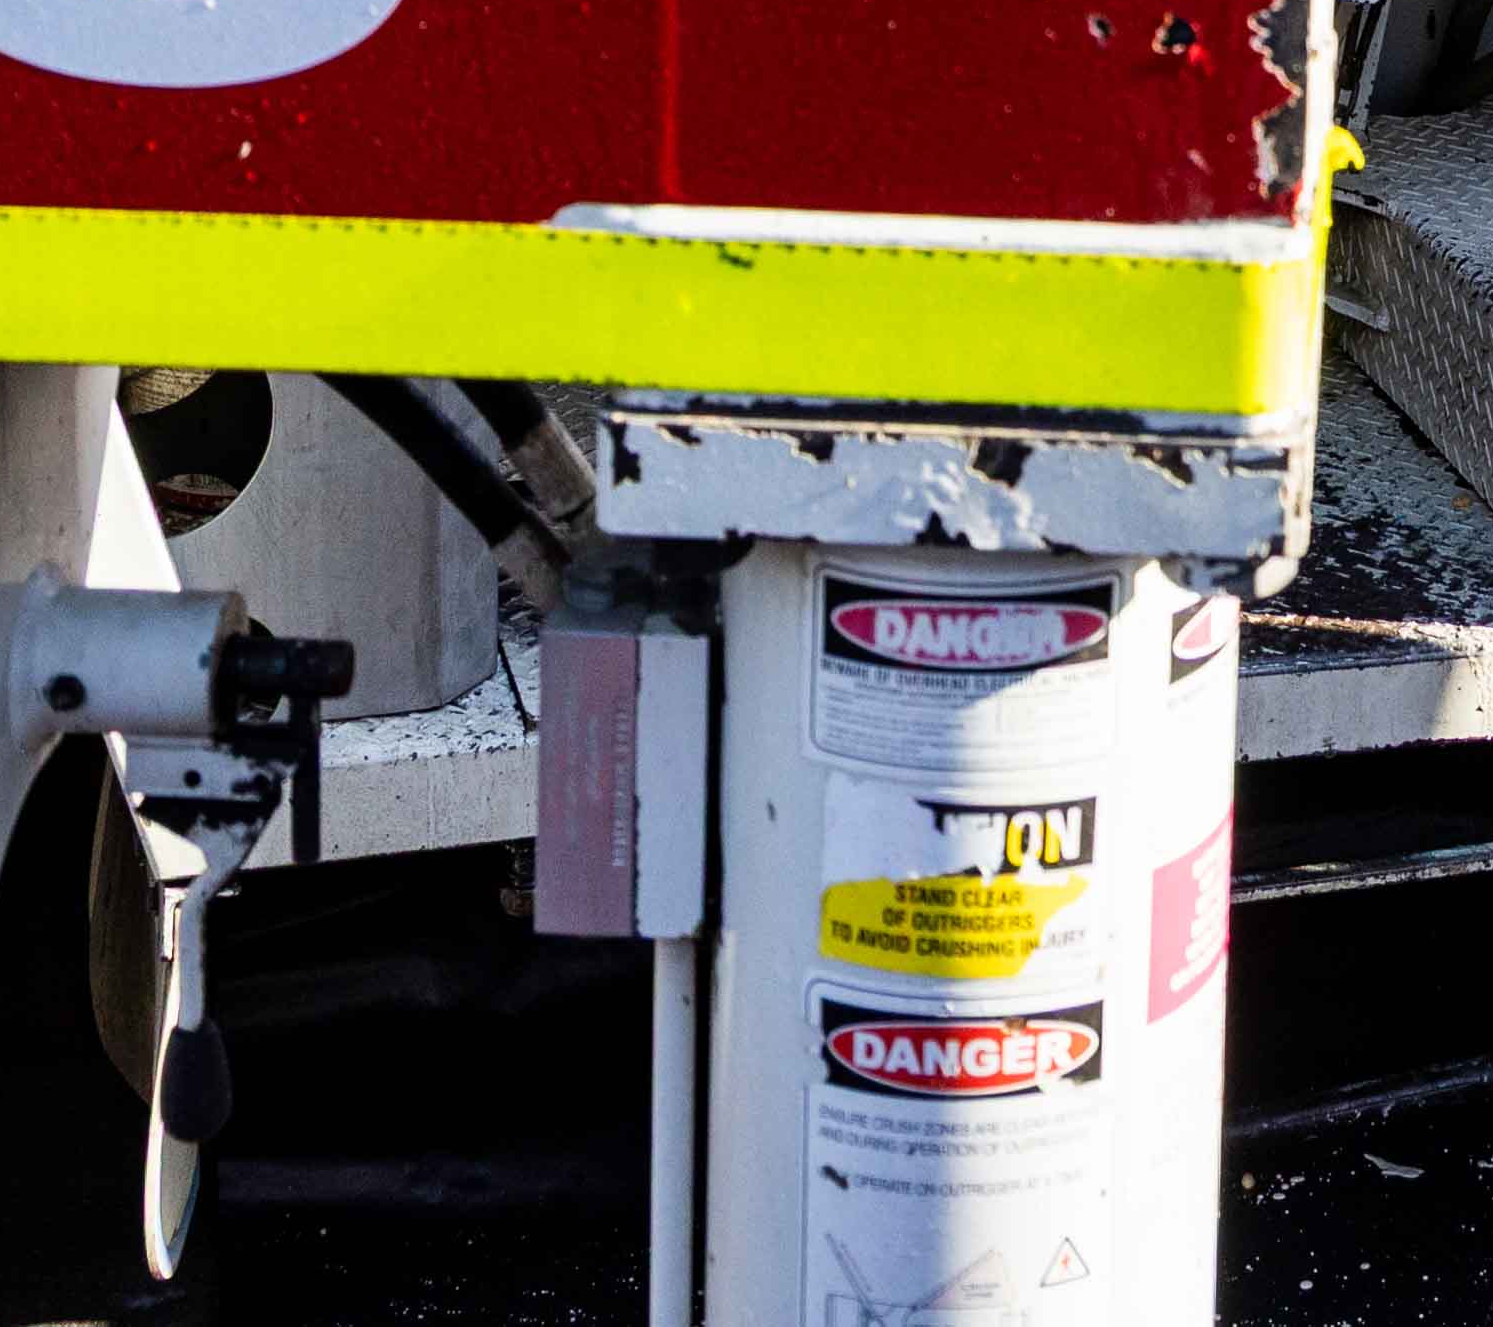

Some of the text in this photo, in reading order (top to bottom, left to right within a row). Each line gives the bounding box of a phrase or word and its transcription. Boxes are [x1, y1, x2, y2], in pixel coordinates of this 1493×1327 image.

[894, 883, 1023, 907] STAND CLEAR
[882, 907, 1035, 932] OF OUTRIGGERS
[831, 920, 852, 943] TO
[856, 926, 911, 954] AVOID
[916, 937, 1014, 958] CRUSHING
[852, 1031, 1073, 1079] DANGER
